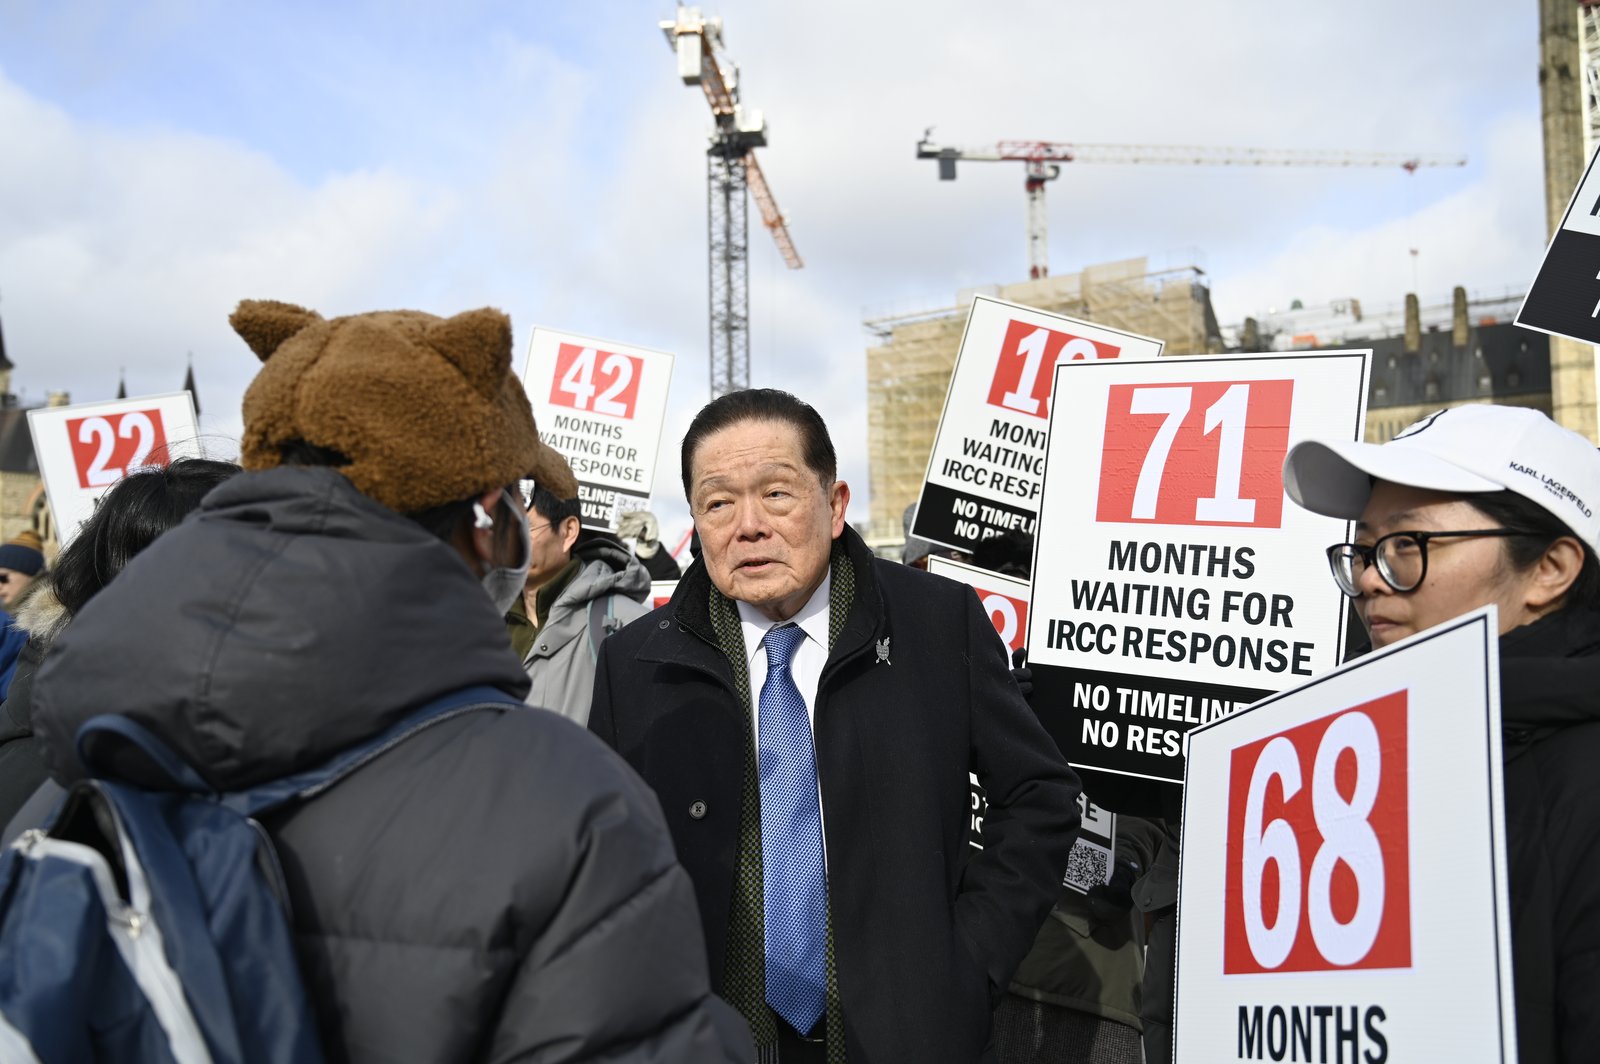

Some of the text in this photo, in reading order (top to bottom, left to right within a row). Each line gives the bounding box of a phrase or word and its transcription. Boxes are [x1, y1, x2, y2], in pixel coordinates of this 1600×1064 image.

[560, 347, 633, 417] 42
[78, 411, 164, 486] 22
[554, 415, 623, 440] MONTHS
[565, 455, 645, 483] ESPONSE
[605, 444, 638, 462] FOR
[1130, 384, 1256, 523] 71
[942, 458, 1041, 500] IRCC RESP
[1509, 461, 1592, 518] KARL LAGERFELD
[952, 498, 978, 518] NO
[980, 505, 1036, 535] TIMELI
[954, 519, 980, 540] NO
[1107, 540, 1256, 580] MONTHS
[1070, 579, 1294, 628] WAITING FOR
[1046, 618, 1315, 677] IRCC RESPONSE
[1073, 682, 1110, 711] NO
[1082, 718, 1119, 748] NO
[1242, 711, 1386, 969] 68
[1237, 1004, 1389, 1064] MONTHS
